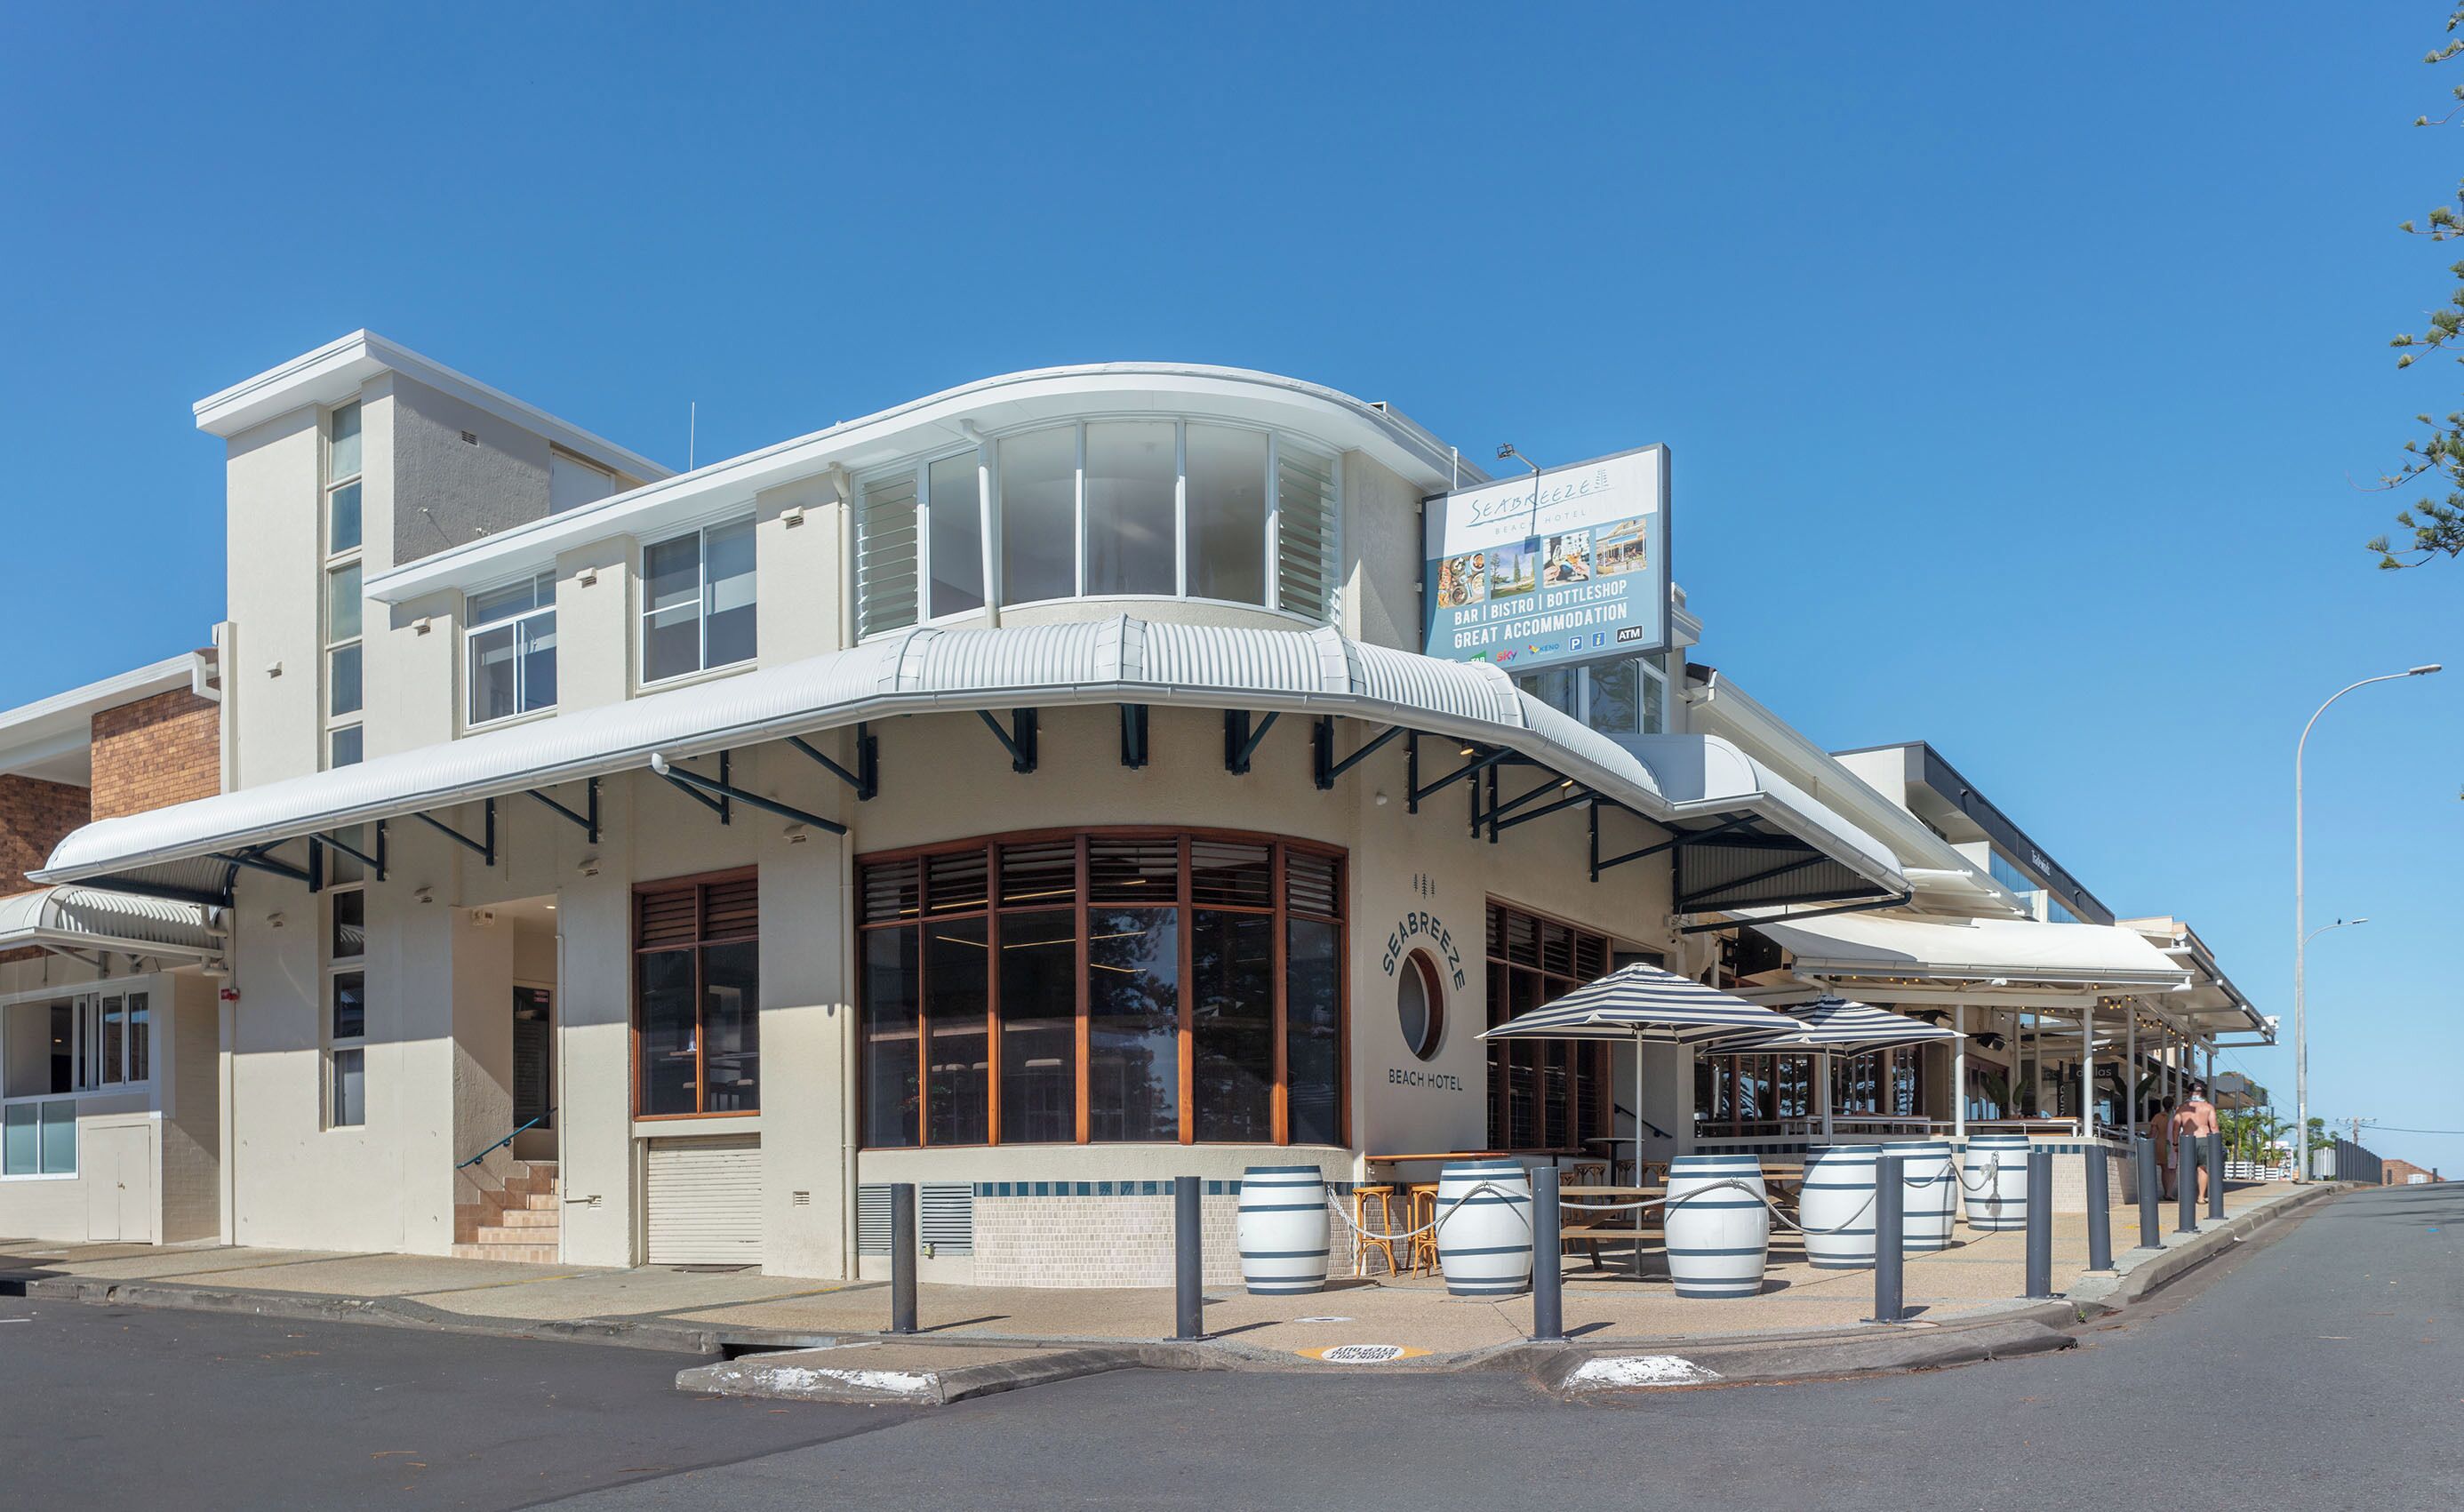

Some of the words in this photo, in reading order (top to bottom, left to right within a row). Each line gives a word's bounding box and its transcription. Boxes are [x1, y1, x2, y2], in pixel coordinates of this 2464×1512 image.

[1471, 479, 1590, 524] SEABREEZE
[1495, 521, 1535, 535] BEACH
[1544, 509, 1587, 524] HOTEL
[1454, 608, 1478, 626] BAR
[1491, 596, 1534, 620] BISTRO
[1547, 580, 1628, 607] BOTTLESHOP
[1454, 627, 1498, 649] GREAT
[1504, 602, 1628, 640] ACCOMMODATION
[1618, 627, 1641, 641] ATM
[1496, 648, 1517, 662] sky
[1539, 643, 1560, 652] KENO
[1571, 638, 1580, 650] P
[1382, 911, 1466, 991] SEABREEZE
[1388, 1068, 1424, 1087] BEACH
[1428, 1074, 1463, 1092] HOTEL
